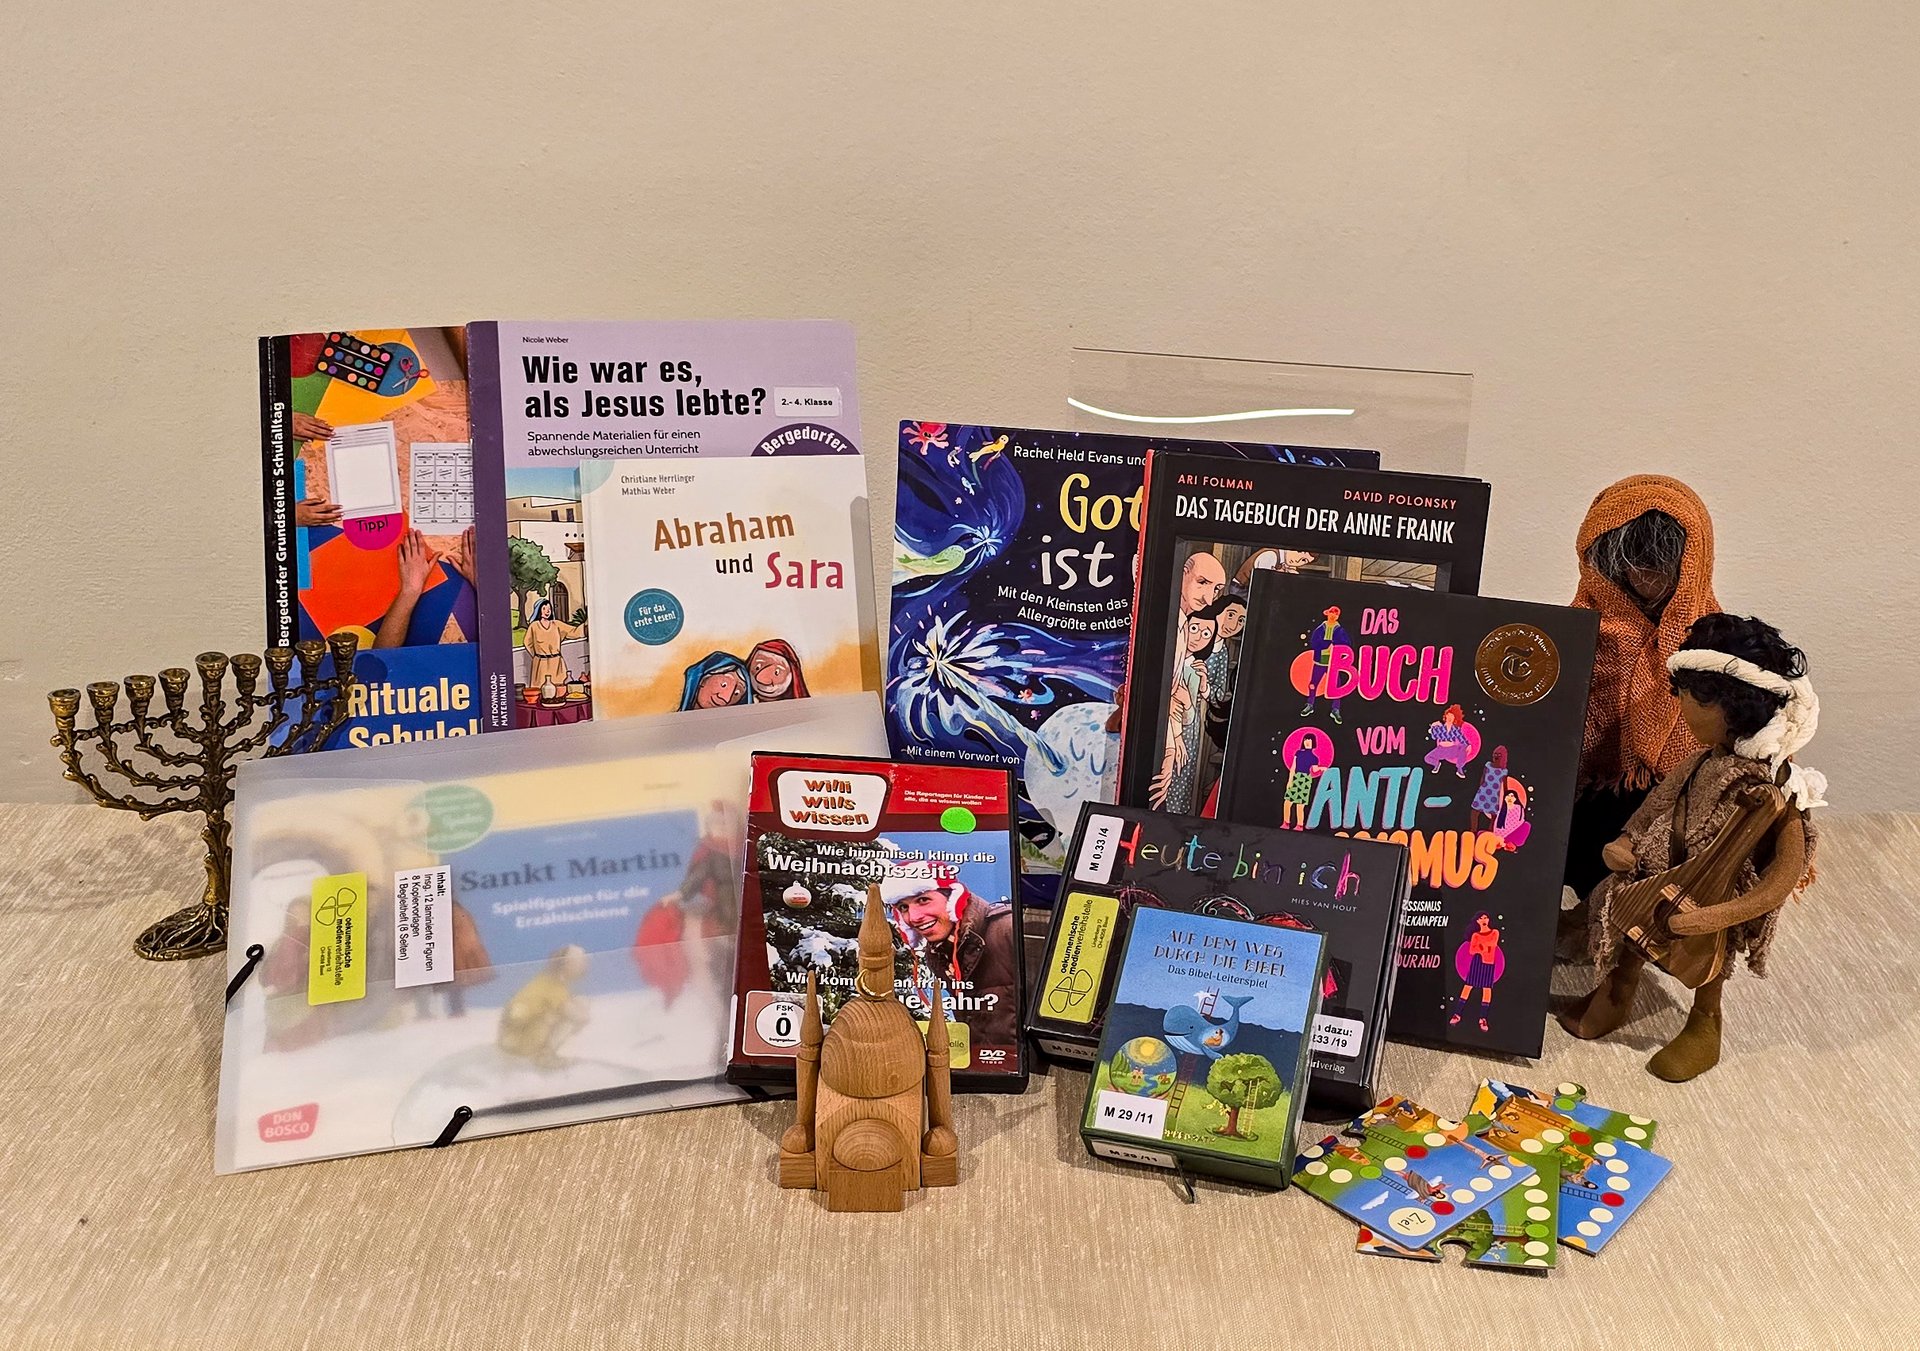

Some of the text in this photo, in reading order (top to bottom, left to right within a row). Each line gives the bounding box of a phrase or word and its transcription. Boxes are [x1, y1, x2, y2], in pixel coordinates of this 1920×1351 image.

[522, 356, 702, 387] Wie war es,
[525, 388, 766, 418] als Jesus lebte?
[528, 430, 700, 443] Spannende Materialien für einen
[761, 426, 847, 455] Bergedorfer
[528, 444, 699, 458] abwechslungsreichen Unterricht
[1014, 446, 1054, 459] Rachel
[1058, 449, 1084, 461] Held
[1088, 451, 1123, 464] Evans
[621, 474, 695, 483] Christiane Herrlinger
[622, 486, 675, 495] Mathias Weber
[1178, 474, 1253, 490] ARI FOLMAN
[1059, 473, 1144, 533] Got
[1344, 490, 1456, 510] DAVID POLONSKY
[272, 402, 292, 646] Bergedorfer Grundsteine Schulalltag
[654, 512, 794, 551] Abraham
[1176, 495, 1455, 544] DAS TAGEBUCH DER ANNE FRANK
[716, 551, 843, 589] und Sara
[1041, 535, 1114, 590] ist
[639, 604, 666, 616] Für das
[998, 586, 1128, 612] Mit den Kleinsten das
[634, 611, 676, 627] erste Lesen!
[1017, 606, 1086, 630] Allergrößte
[1361, 608, 1399, 635] DAS
[1324, 644, 1453, 704] BUCH
[348, 678, 470, 717] Rituale
[1356, 726, 1405, 755] VOM
[907, 745, 1020, 764] Mit einem Vorwort von
[1306, 767, 1452, 830] ANTI-
[816, 845, 995, 863] Wie himmlisch klingt die
[1089, 828, 1108, 871] M 0.33 /4
[460, 849, 681, 892] Sankt Martin
[767, 853, 960, 879] Weihnachtszeit?
[1232, 843, 1282, 885] bin
[1299, 849, 1360, 900] ich
[437, 872, 446, 896] Inhalt:
[397, 882, 409, 923] Begleitheft
[410, 881, 421, 937] Kopiervorlagen
[1292, 898, 1357, 912] MIES VAN HOUT
[1402, 900, 1442, 912] SSISMUS
[422, 874, 434, 971] Insg. 12 laminierte Figuren
[397, 932, 409, 961] Seiten)
[1061, 916, 1080, 973] oekumenische
[1069, 900, 1092, 975] medienverleihstelle
[1167, 930, 1283, 958] AUF DEM WEG
[1400, 936, 1430, 949] WELL
[1154, 945, 1287, 978] DURCH DIE BIBEL
[786, 972, 808, 984] Wi
[820, 974, 853, 985] kom
[894, 979, 914, 988] an
[952, 979, 974, 990] ins
[1168, 965, 1268, 988] Das Bibel-Leiterspiel
[943, 992, 999, 1011] ahr?
[776, 1017, 791, 1036] 0
[1325, 1025, 1352, 1036] dazu:
[1331, 1038, 1347, 1047] /19
[273, 1111, 302, 1124] DON
[1104, 1106, 1153, 1124] M 29 /11
[265, 1123, 310, 1137] BOSCO
[1397, 1212, 1426, 1231] Ziel
